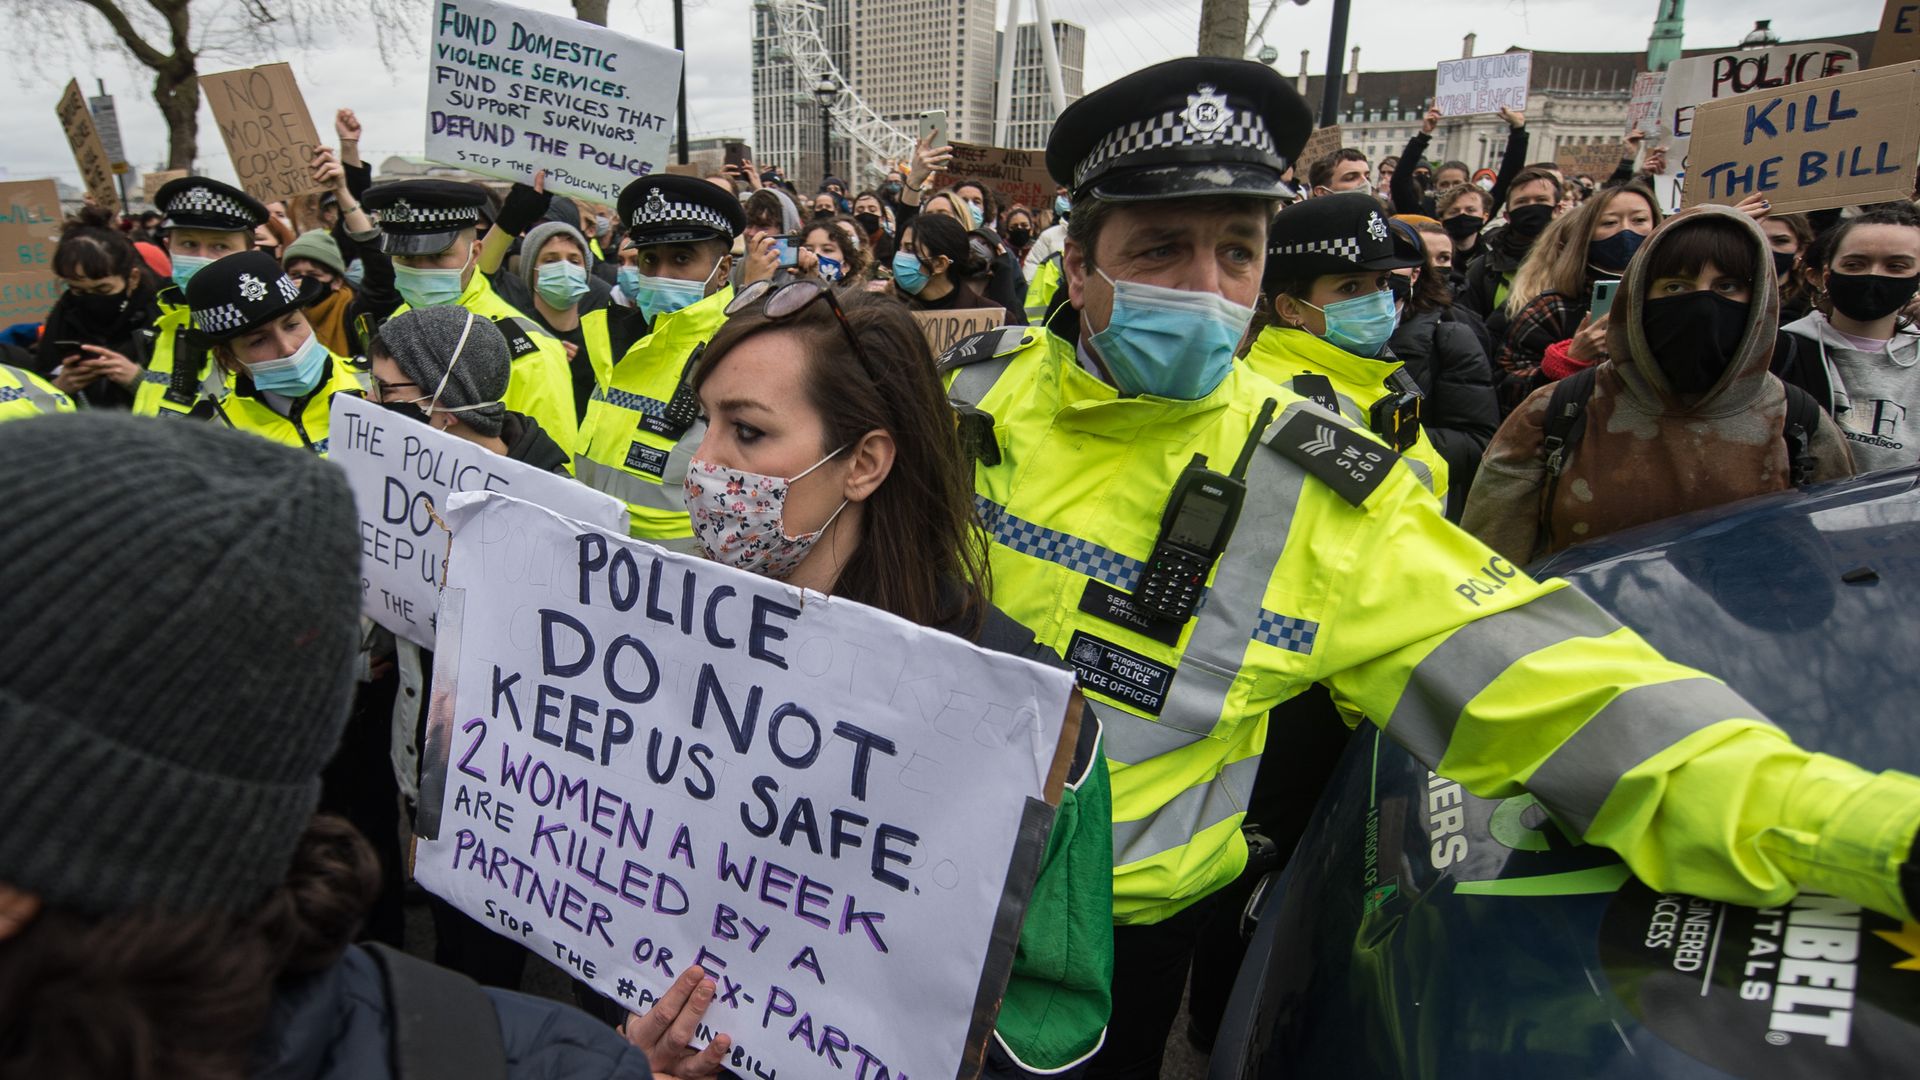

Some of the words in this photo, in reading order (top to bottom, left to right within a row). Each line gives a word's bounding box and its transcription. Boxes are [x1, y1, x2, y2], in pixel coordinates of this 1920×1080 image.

[440, 3, 497, 46] FUND
[507, 22, 618, 72] DOMESTIC
[223, 71, 273, 111] NO
[437, 43, 523, 76] VIOLENCE
[531, 63, 631, 100] SERVICES.
[1438, 55, 1527, 86] POLICING
[1712, 51, 1852, 98] POLICE
[436, 66, 496, 94] FUND
[507, 83, 609, 119] SERVICES
[617, 106, 667, 133] THAT
[446, 90, 531, 120] SUPPORT
[542, 110, 637, 144] SURVIVORS.
[1436, 87, 1525, 116] VIOLENCE
[1744, 89, 1858, 145] KILL
[220, 113, 303, 152] MORE
[431, 111, 515, 147] DEFUND
[524, 131, 568, 157] THE
[579, 142, 654, 177] POLICE
[238, 147, 292, 179] COPS
[300, 144, 315, 163] O
[457, 150, 501, 167] STOP
[506, 160, 533, 174] THE
[1701, 156, 1783, 199] THE
[1798, 142, 1900, 187] BILL
[246, 177, 277, 201] OUR
[18, 243, 48, 264] BE
[919, 317, 960, 352] YOUR
[344, 413, 384, 457] THE
[1336, 445, 1362, 469] SW
[1350, 452, 1382, 482] 560
[382, 476, 435, 536] DO
[360, 521, 414, 570] EEP
[575, 532, 800, 670] POLICE
[1106, 594, 1134, 612] SERG
[1455, 556, 1516, 606] POLIC
[380, 589, 416, 625] THE
[1109, 605, 1149, 628] FITTALL
[1107, 652, 1160, 679] METROPOLITAN
[1110, 663, 1151, 686] POLICE
[538, 608, 660, 704] DO
[692, 663, 898, 801] NOT
[1109, 680, 1159, 707] OFFICER
[492, 664, 634, 767] KEEP
[647, 728, 716, 800] US
[456, 717, 487, 783] 2
[501, 742, 654, 850] WOMEN
[669, 822, 696, 869] A
[717, 841, 888, 953] WEEK
[740, 775, 921, 895] SAFE.
[1364, 818, 1379, 869] DIVISION
[454, 785, 515, 833] ARE
[530, 814, 690, 915] KILLED
[712, 903, 770, 953] BY
[788, 946, 826, 985] A
[1364, 868, 1377, 886] OF
[452, 829, 614, 948] PARTNER
[632, 937, 675, 978] OR
[484, 900, 534, 938] STOP
[553, 941, 598, 980] THE
